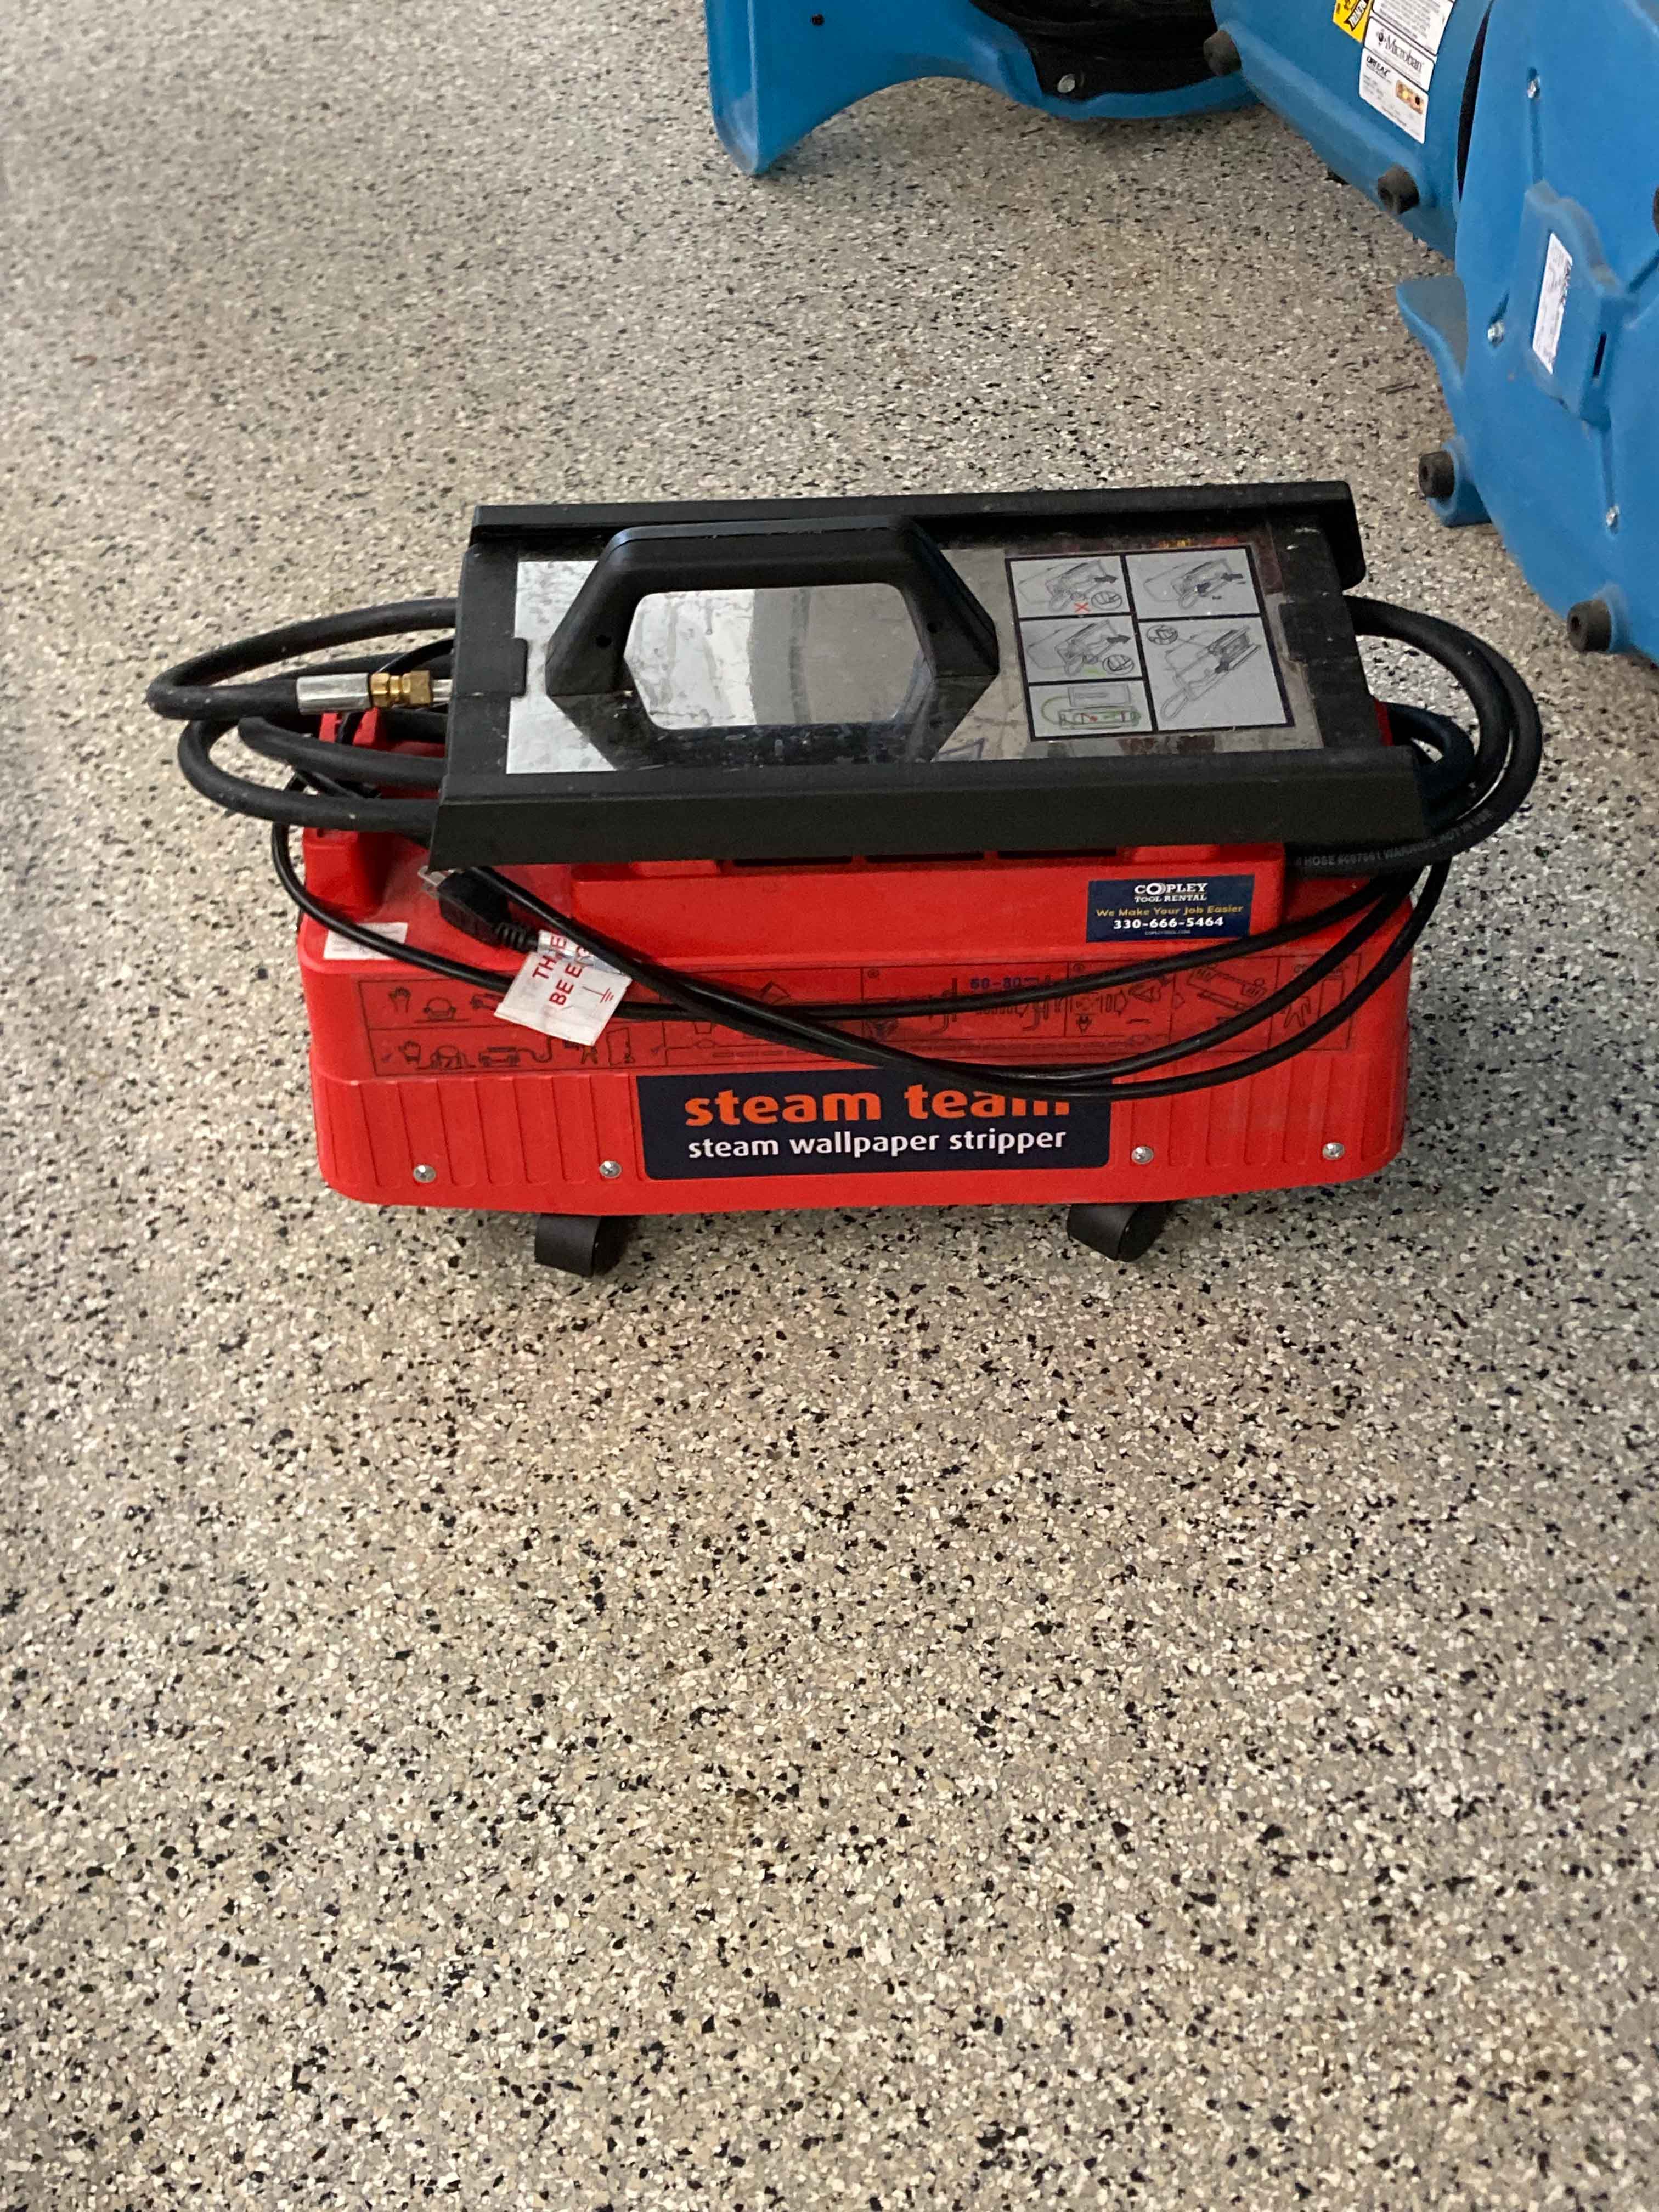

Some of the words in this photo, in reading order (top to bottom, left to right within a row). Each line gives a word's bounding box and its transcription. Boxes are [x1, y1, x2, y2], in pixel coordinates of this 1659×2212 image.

[1385, 35, 1422, 72] Microban
[1134, 882, 1208, 895] COPLEY
[1164, 894, 1207, 902] RENTAL
[1096, 909, 1115, 917] We
[1119, 908, 1150, 916] Make
[1154, 907, 1180, 916] Your
[1184, 906, 1203, 916] Job
[1207, 905, 1244, 914] Easier
[1113, 917, 1224, 930] 330-666-5464
[684, 1089, 881, 1126] steam
[689, 1136, 779, 1159] steam
[790, 1130, 939, 1158] wallpaper
[950, 1127, 1067, 1155] stripper
